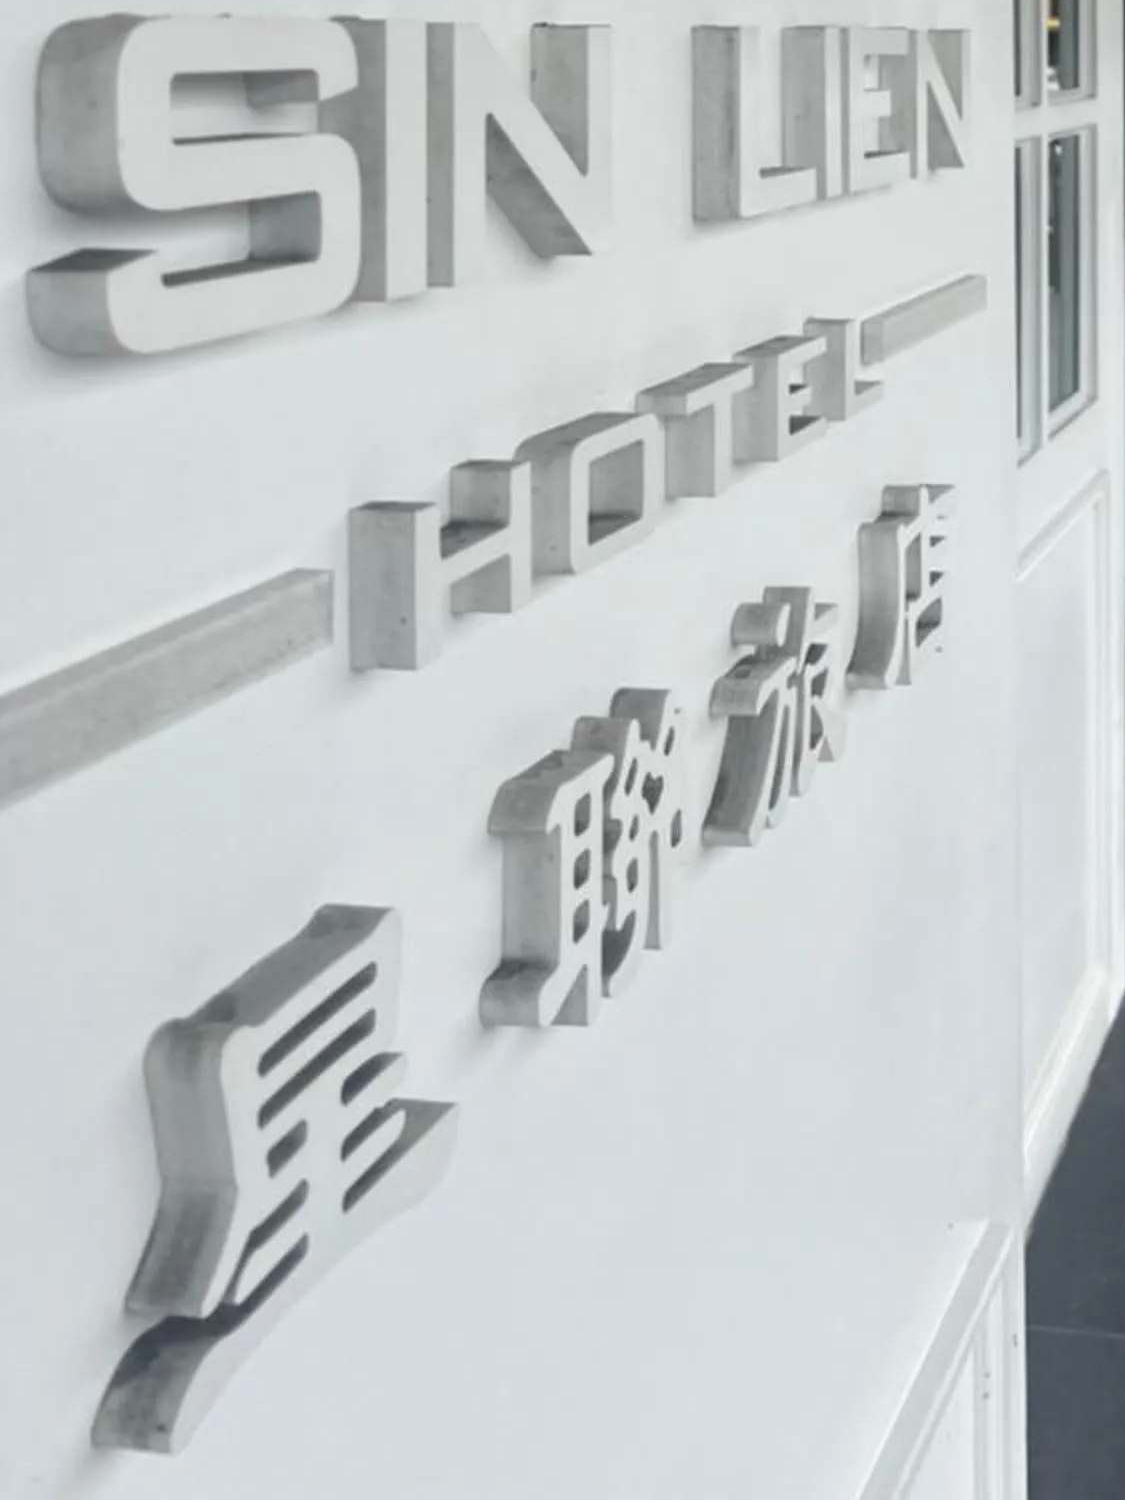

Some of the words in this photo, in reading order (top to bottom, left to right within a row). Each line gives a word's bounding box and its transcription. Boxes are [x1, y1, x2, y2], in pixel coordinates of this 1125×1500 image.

[27, 12, 612, 356] SIN
[690, 24, 972, 223] LIEN
[348, 316, 884, 673] HOTEL
[90, 484, 957, 1455] 星聯旅店
